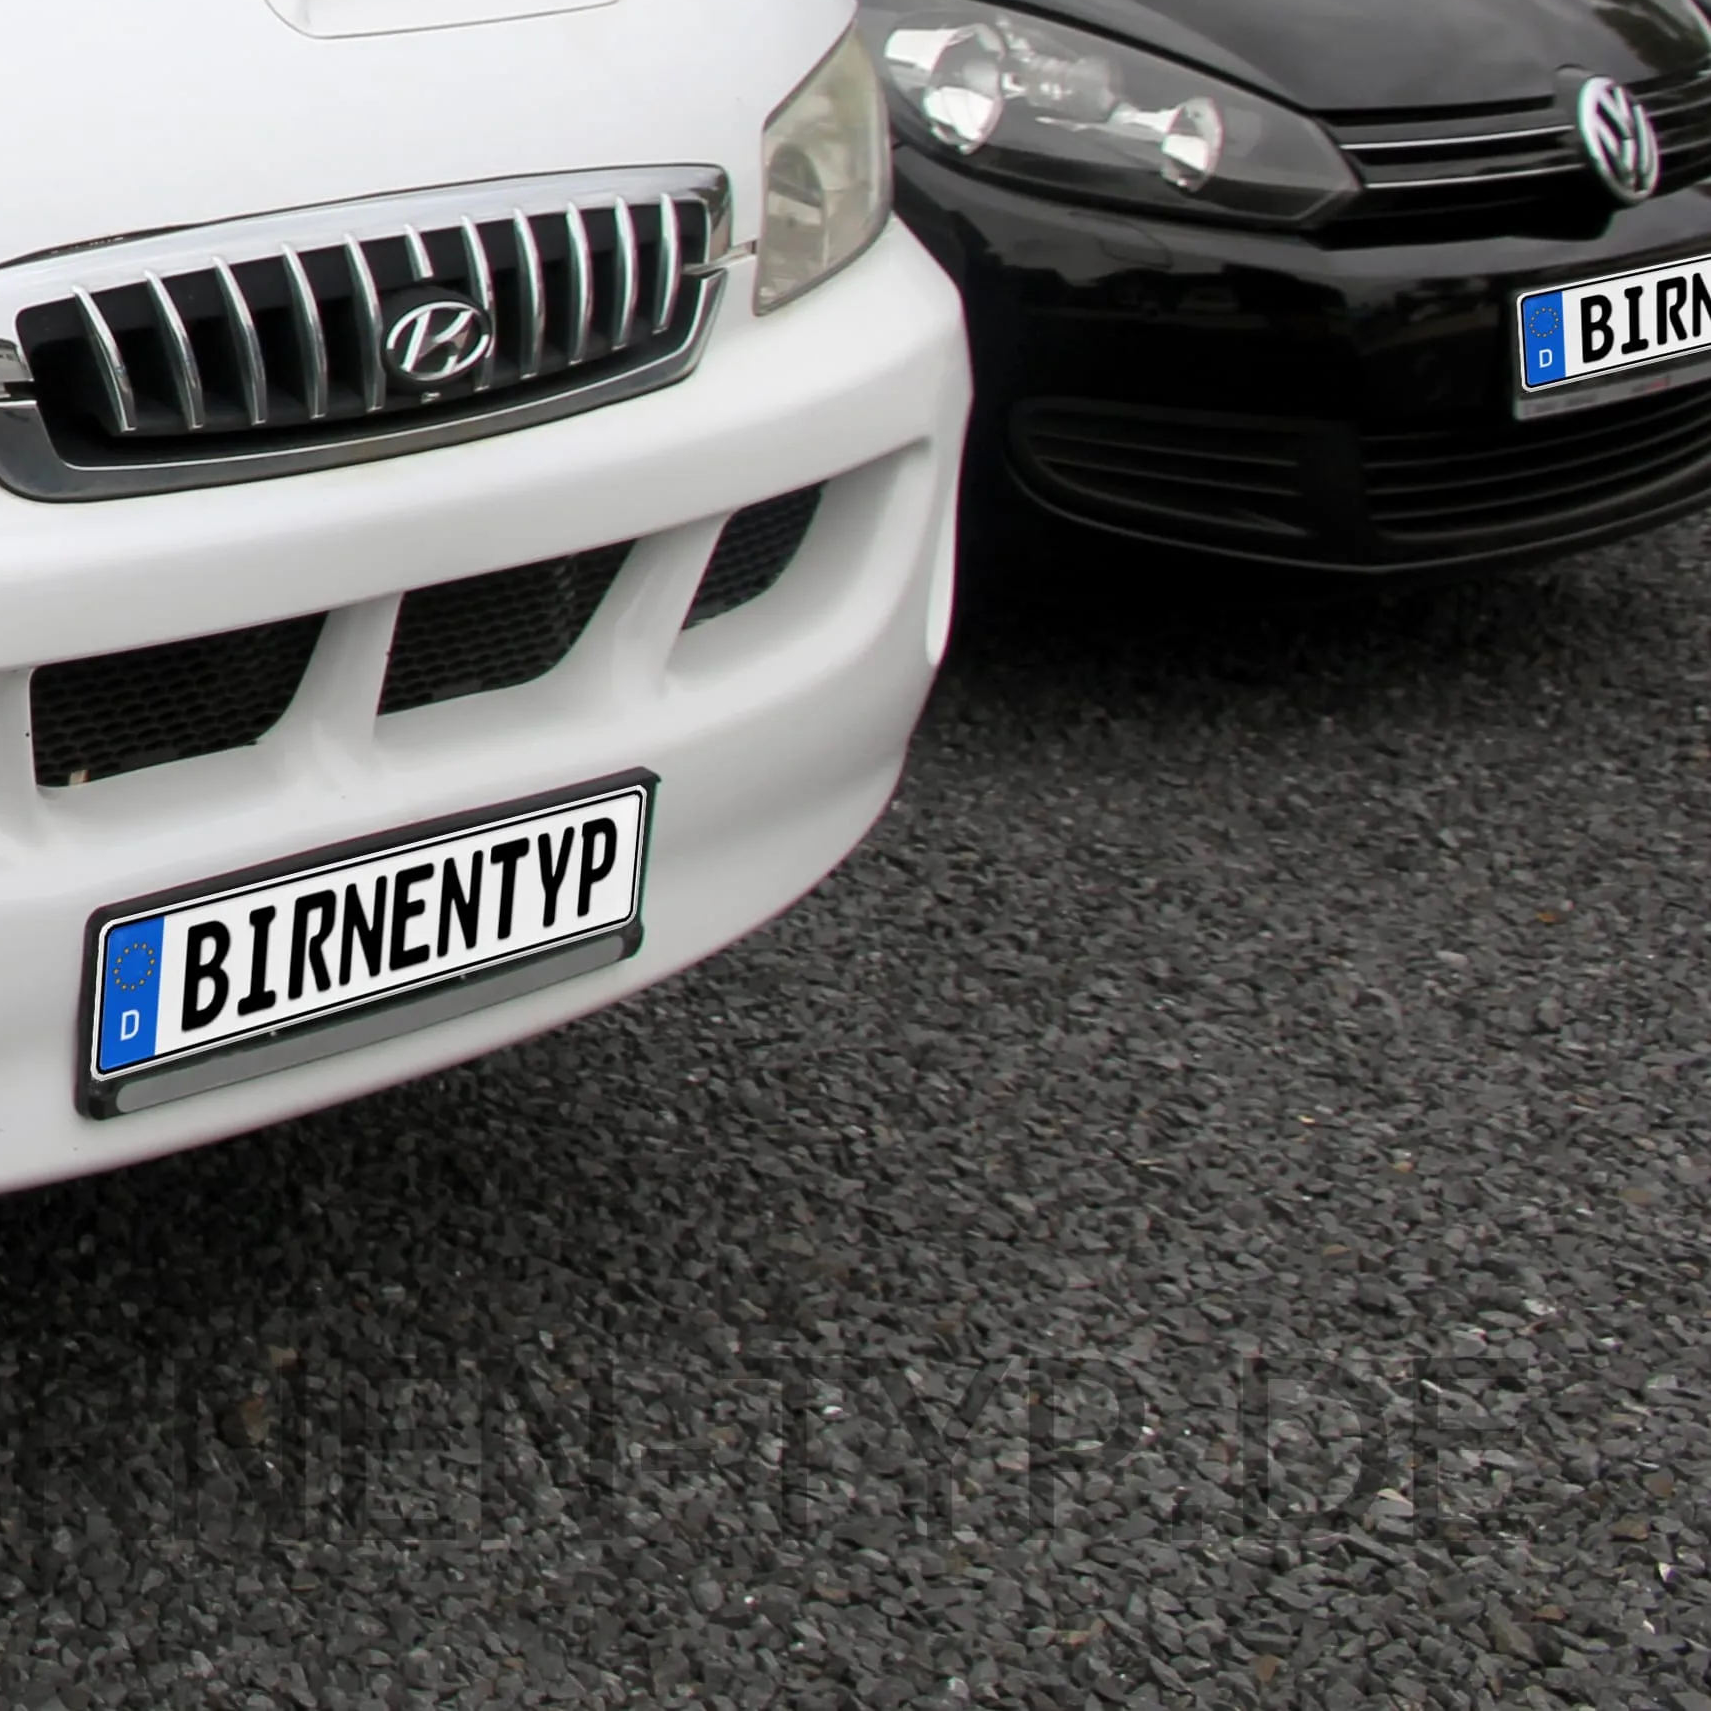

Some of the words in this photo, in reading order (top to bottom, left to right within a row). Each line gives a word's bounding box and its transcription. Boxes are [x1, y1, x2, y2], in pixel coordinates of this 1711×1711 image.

[1539, 348, 1554, 369] D
[120, 1009, 141, 1041] D
[180, 817, 618, 1033] BIRNENTYP
